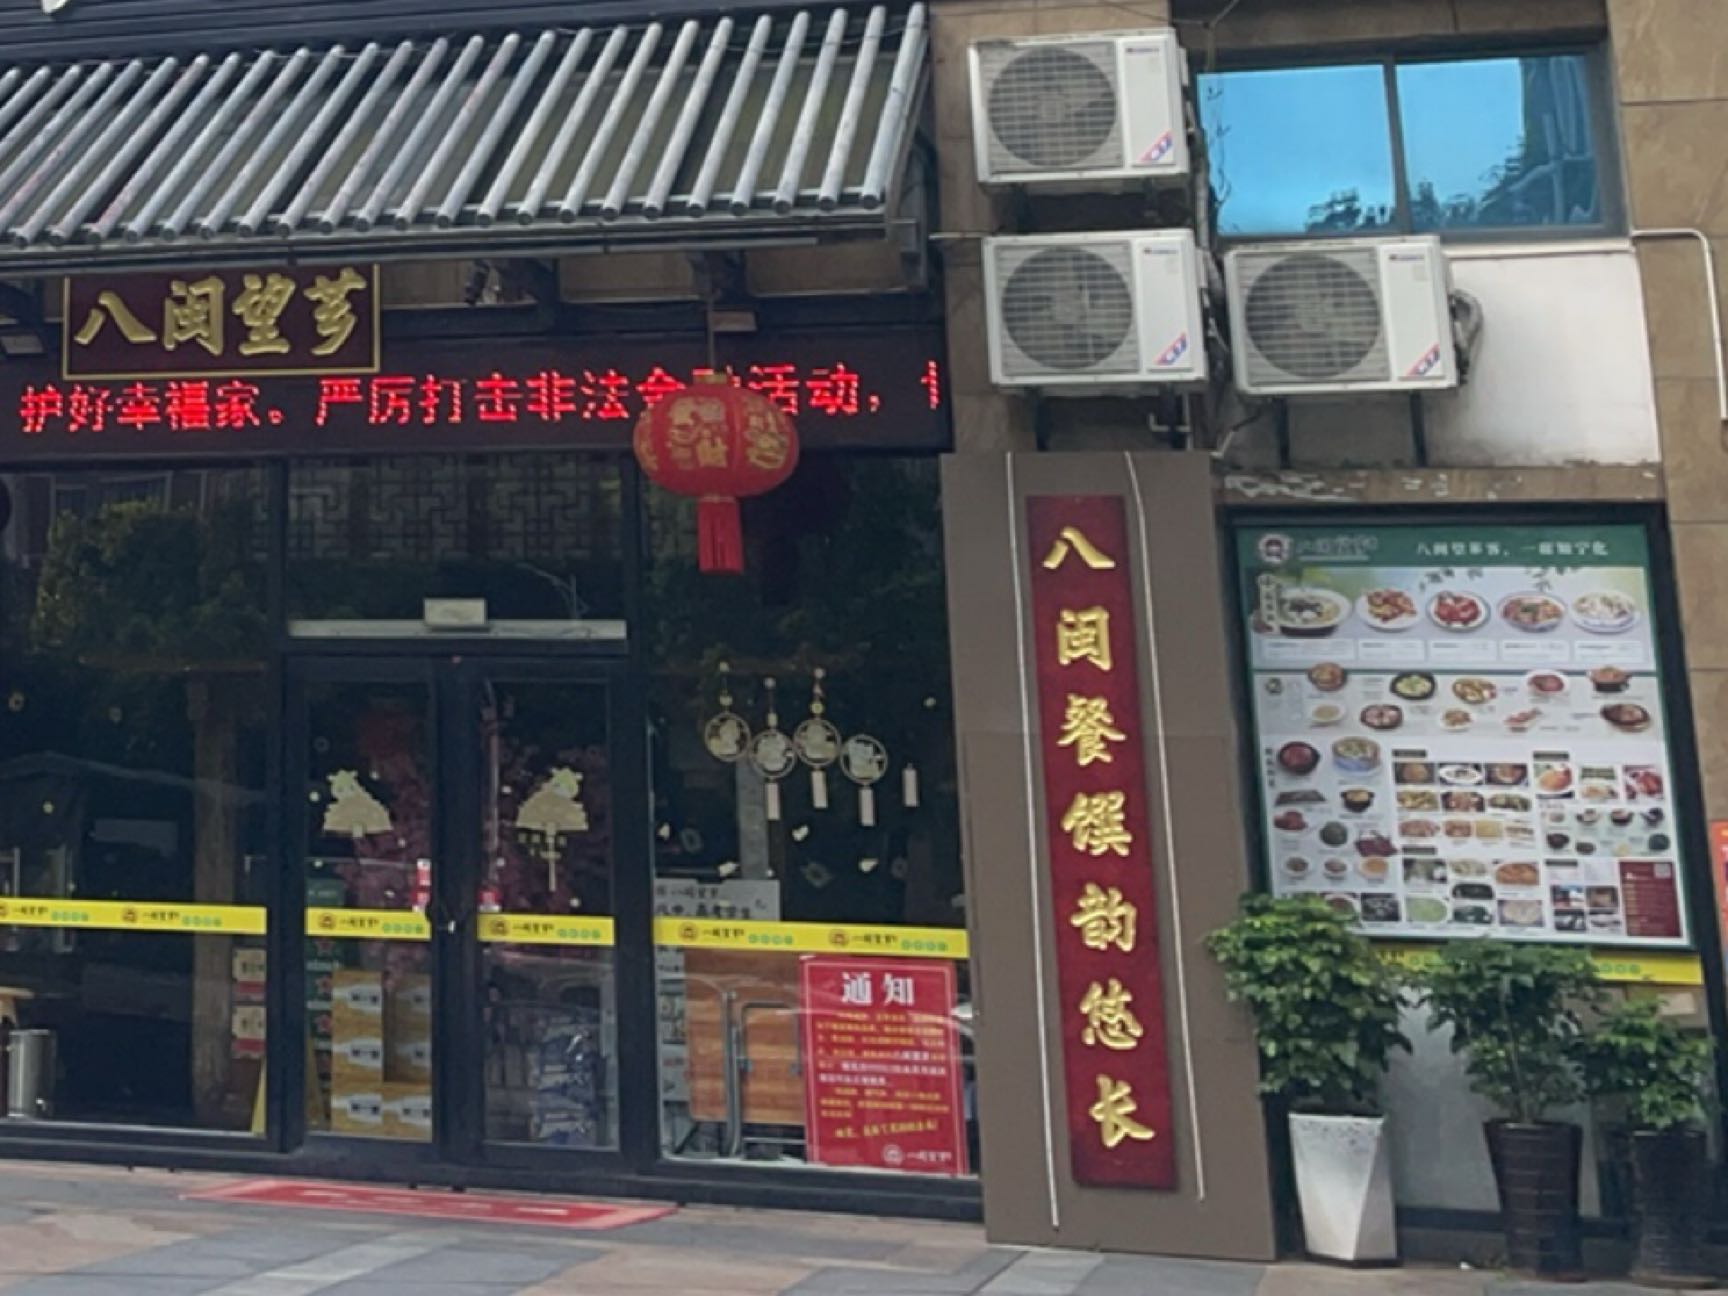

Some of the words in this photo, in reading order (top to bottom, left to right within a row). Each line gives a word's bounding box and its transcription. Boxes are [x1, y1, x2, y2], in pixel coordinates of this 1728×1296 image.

[75, 267, 368, 356] 八闽望芗
[841, 971, 915, 1006] 通知
